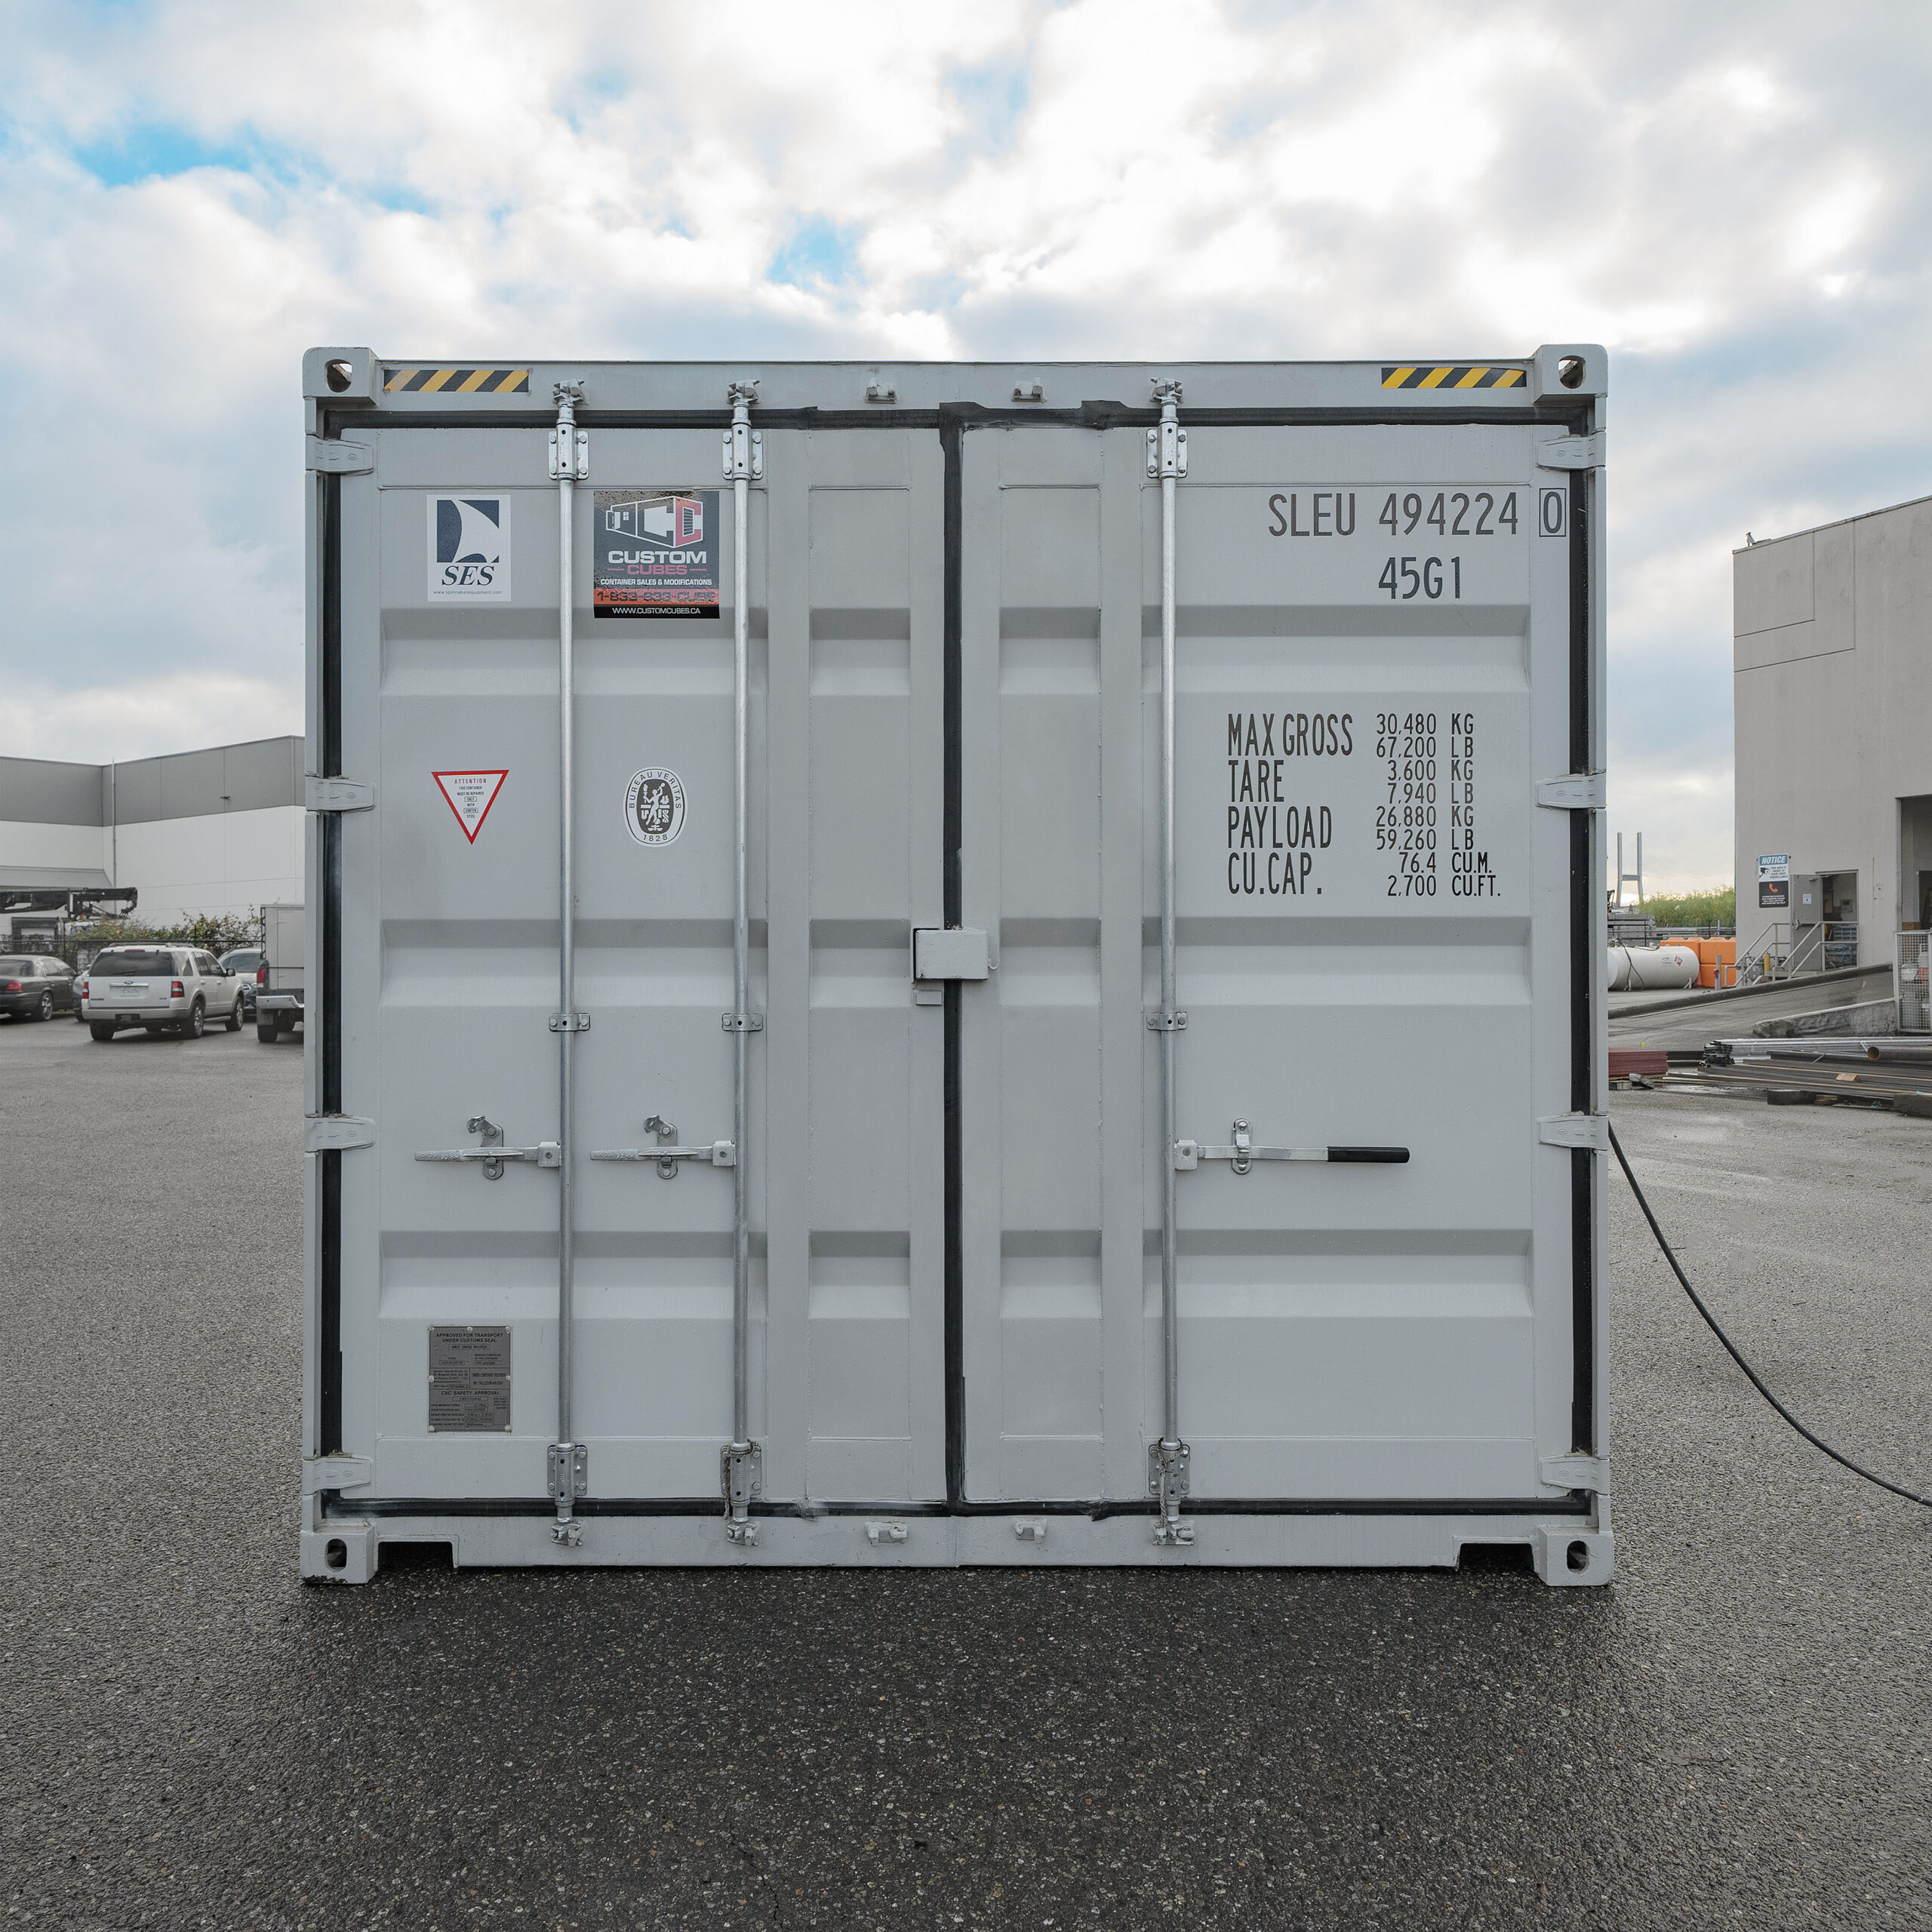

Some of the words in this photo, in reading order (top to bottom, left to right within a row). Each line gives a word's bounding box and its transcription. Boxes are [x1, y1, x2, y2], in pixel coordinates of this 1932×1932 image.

[1269, 493, 1356, 537] SLEU
[1380, 492, 1518, 537] 494224
[1543, 491, 1563, 534] 0
[608, 551, 706, 564] CUSTOM
[441, 565, 495, 586] SES
[627, 565, 688, 575] CUBES
[1379, 557, 1461, 601] 45G1
[1228, 713, 1275, 757] MAX
[1283, 713, 1354, 757] GROSS
[1377, 713, 1437, 736] 30,480
[1451, 713, 1475, 736] KG
[1377, 737, 1437, 758] 67,200
[1228, 760, 1285, 804] TARE
[1388, 760, 1437, 782] 3,600
[1451, 760, 1474, 782] KG
[629, 771, 653, 809] BUREAU
[657, 771, 682, 809] VERITAS
[1388, 783, 1437, 805] 7,940
[1228, 806, 1333, 850] PAYLOAD
[1377, 806, 1437, 828] 26,880
[1451, 806, 1475, 828] KG
[643, 833, 668, 842] 1828
[1377, 829, 1437, 851] 59,260
[1399, 852, 1437, 874] 76.4
[1451, 852, 1493, 874] CU.M.
[1761, 856, 1786, 864] NOTICE
[1228, 852, 1323, 896] CU.CAP.
[1388, 875, 1437, 897] 2,700
[1451, 875, 1502, 897] CU.FT.
